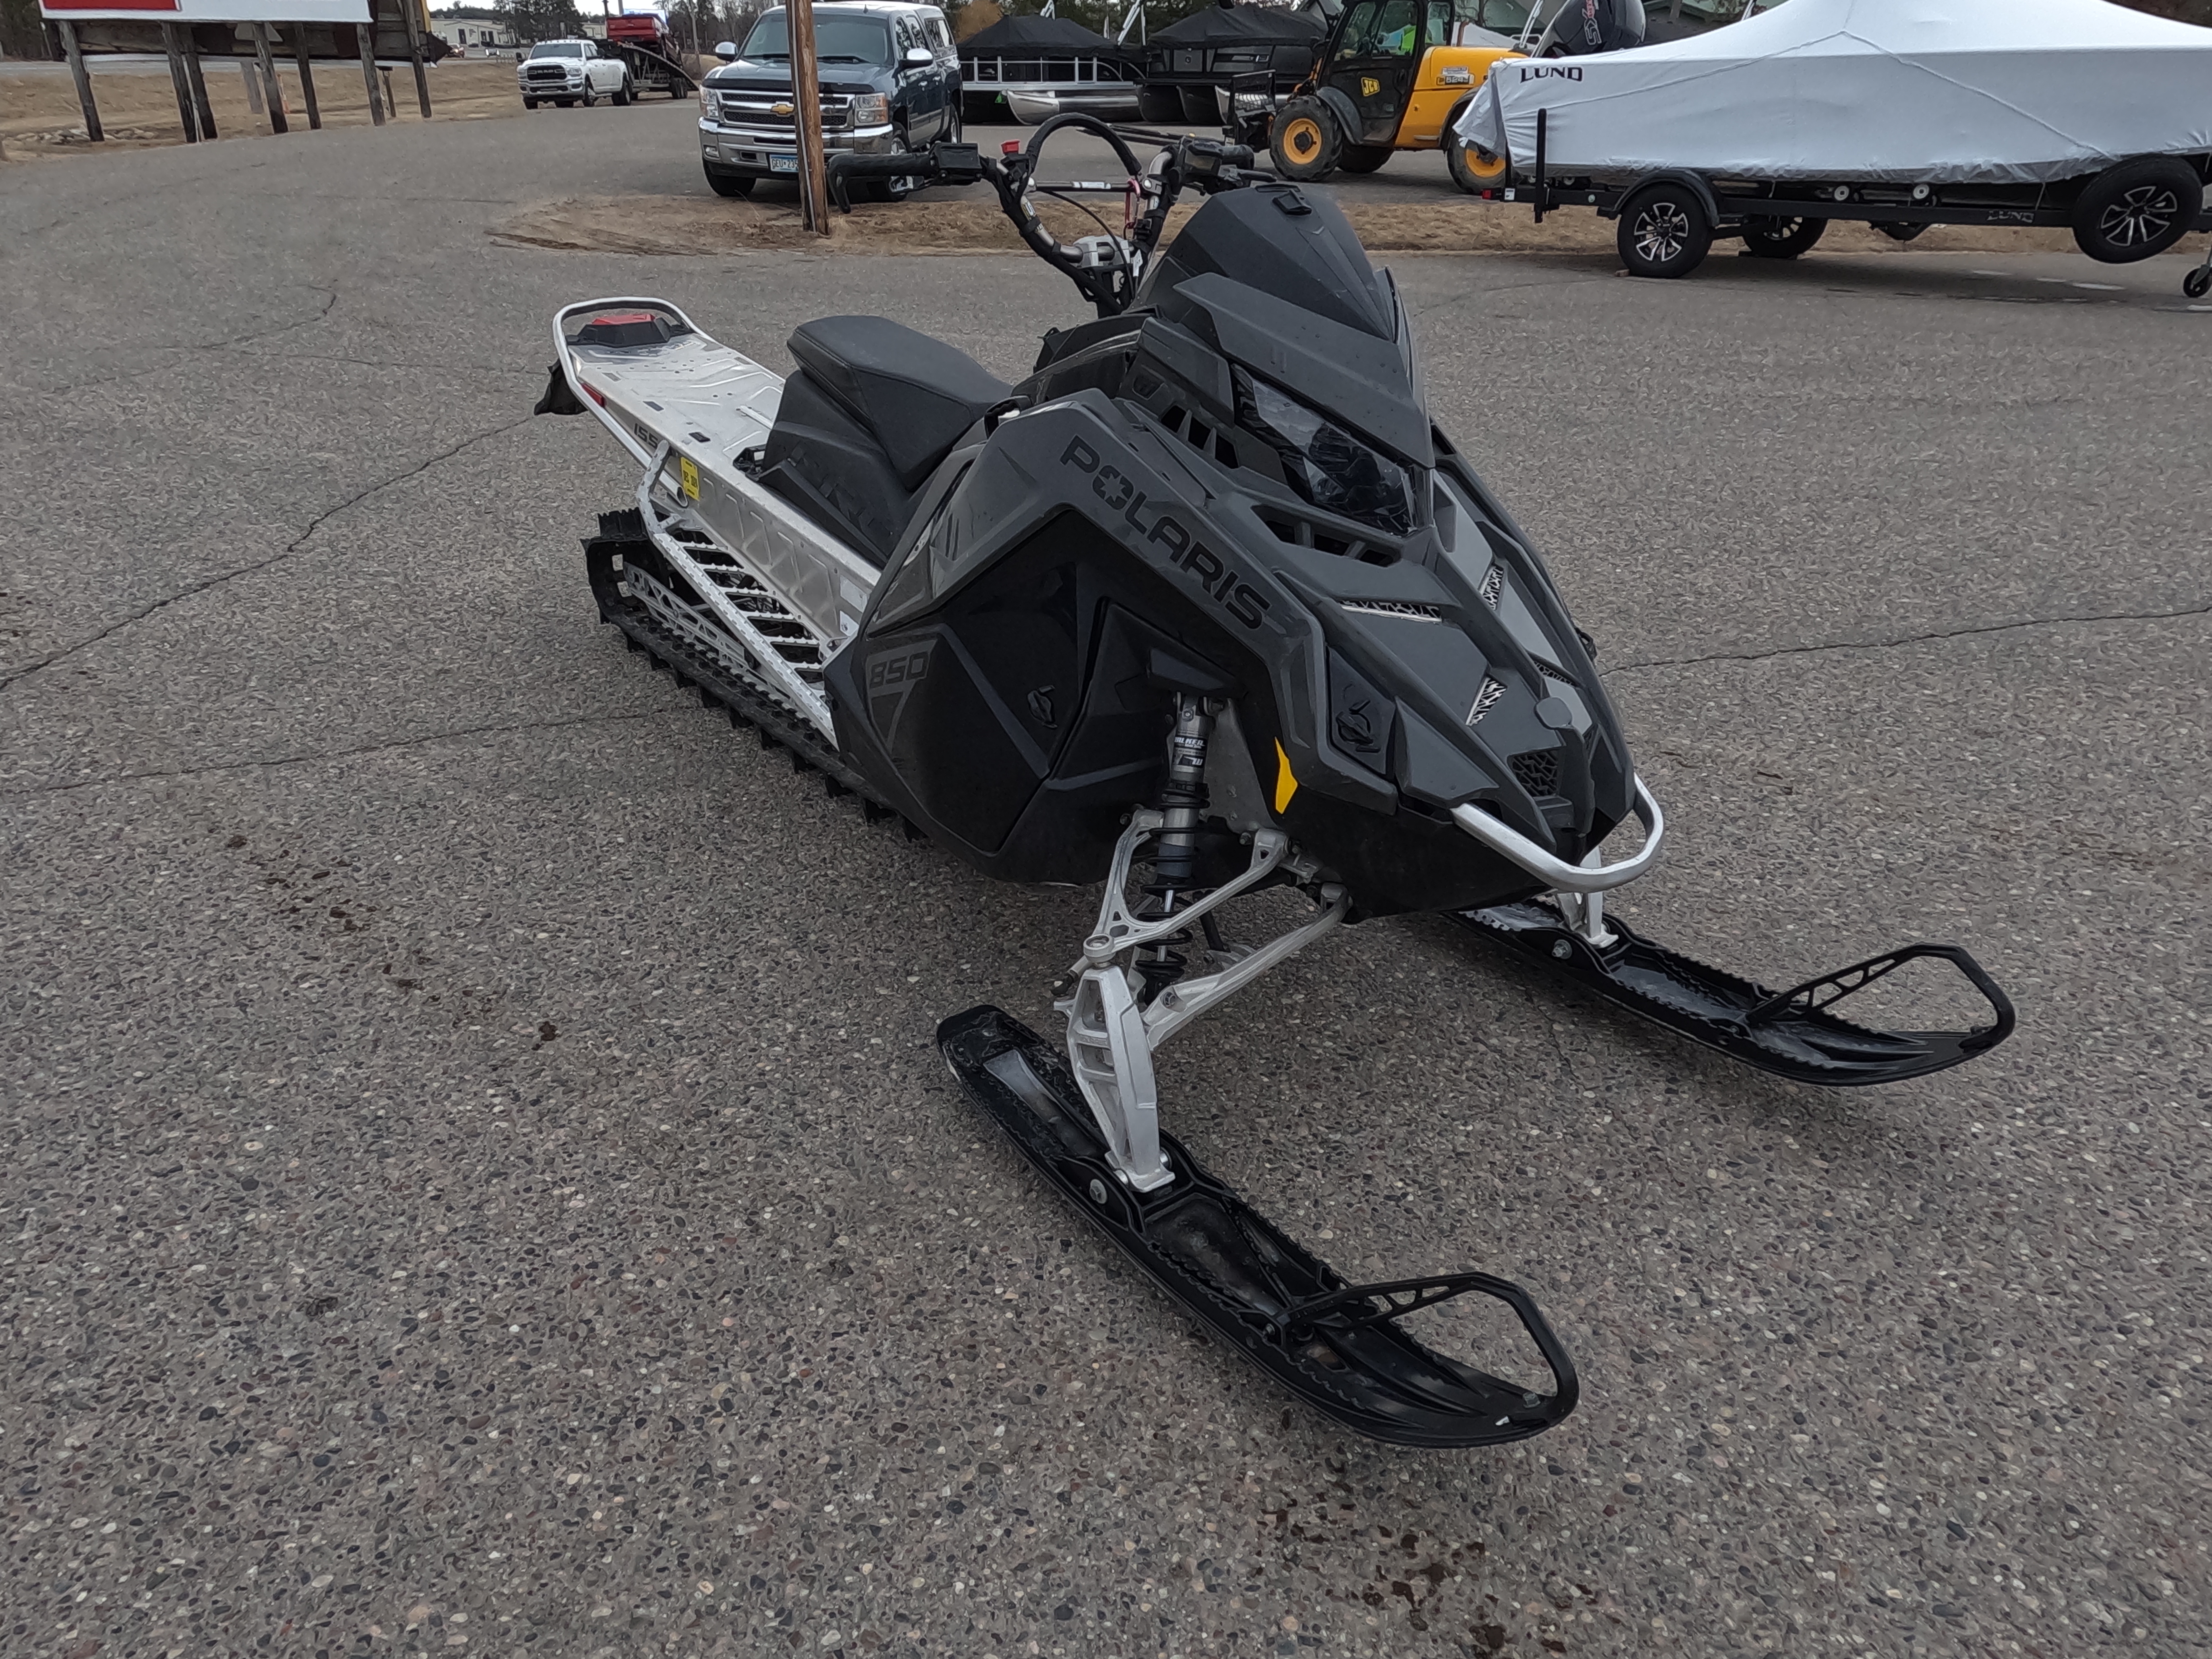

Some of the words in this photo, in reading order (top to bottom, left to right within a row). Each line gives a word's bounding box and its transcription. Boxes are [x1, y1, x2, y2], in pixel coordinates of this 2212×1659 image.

[1364, 79, 1378, 94] JCB
[1520, 67, 1583, 84] LUND
[634, 423, 658, 449] 155
[1060, 435, 1271, 630] POLARIS
[869, 652, 930, 690] 850
